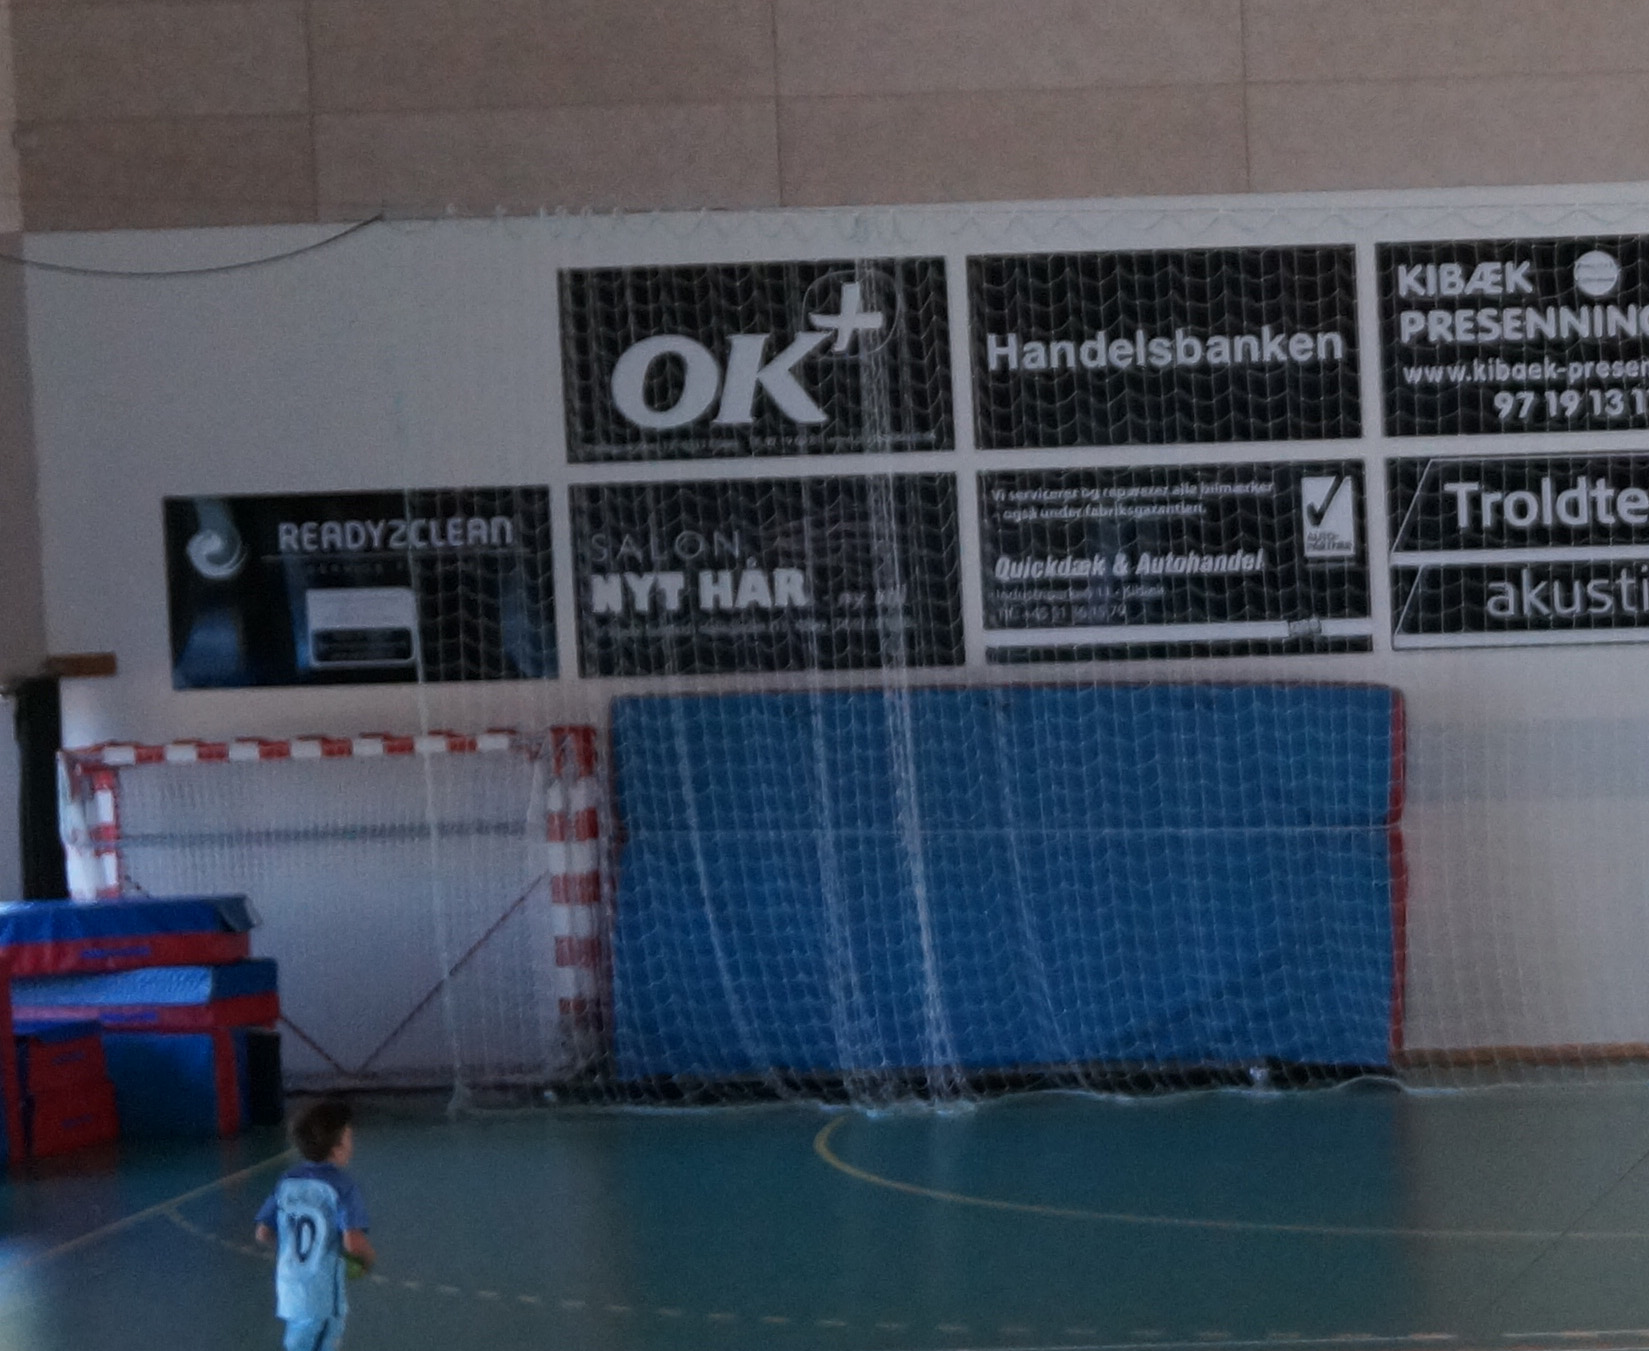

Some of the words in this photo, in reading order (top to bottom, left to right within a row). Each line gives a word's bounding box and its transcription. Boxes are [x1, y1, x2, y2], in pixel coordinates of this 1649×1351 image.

[1398, 261, 1533, 295] KIBÆK
[986, 325, 1343, 371] Handelsbanken
[1494, 392, 1535, 418] 97
[1546, 390, 1581, 417] 19
[1590, 389, 1625, 416] 13
[591, 530, 739, 561] SALON
[996, 554, 1105, 579] Quickdæk
[1113, 552, 1130, 576] &
[1136, 549, 1264, 574] Autohandel
[592, 571, 684, 613] NYT
[699, 556, 809, 609] HÅR
